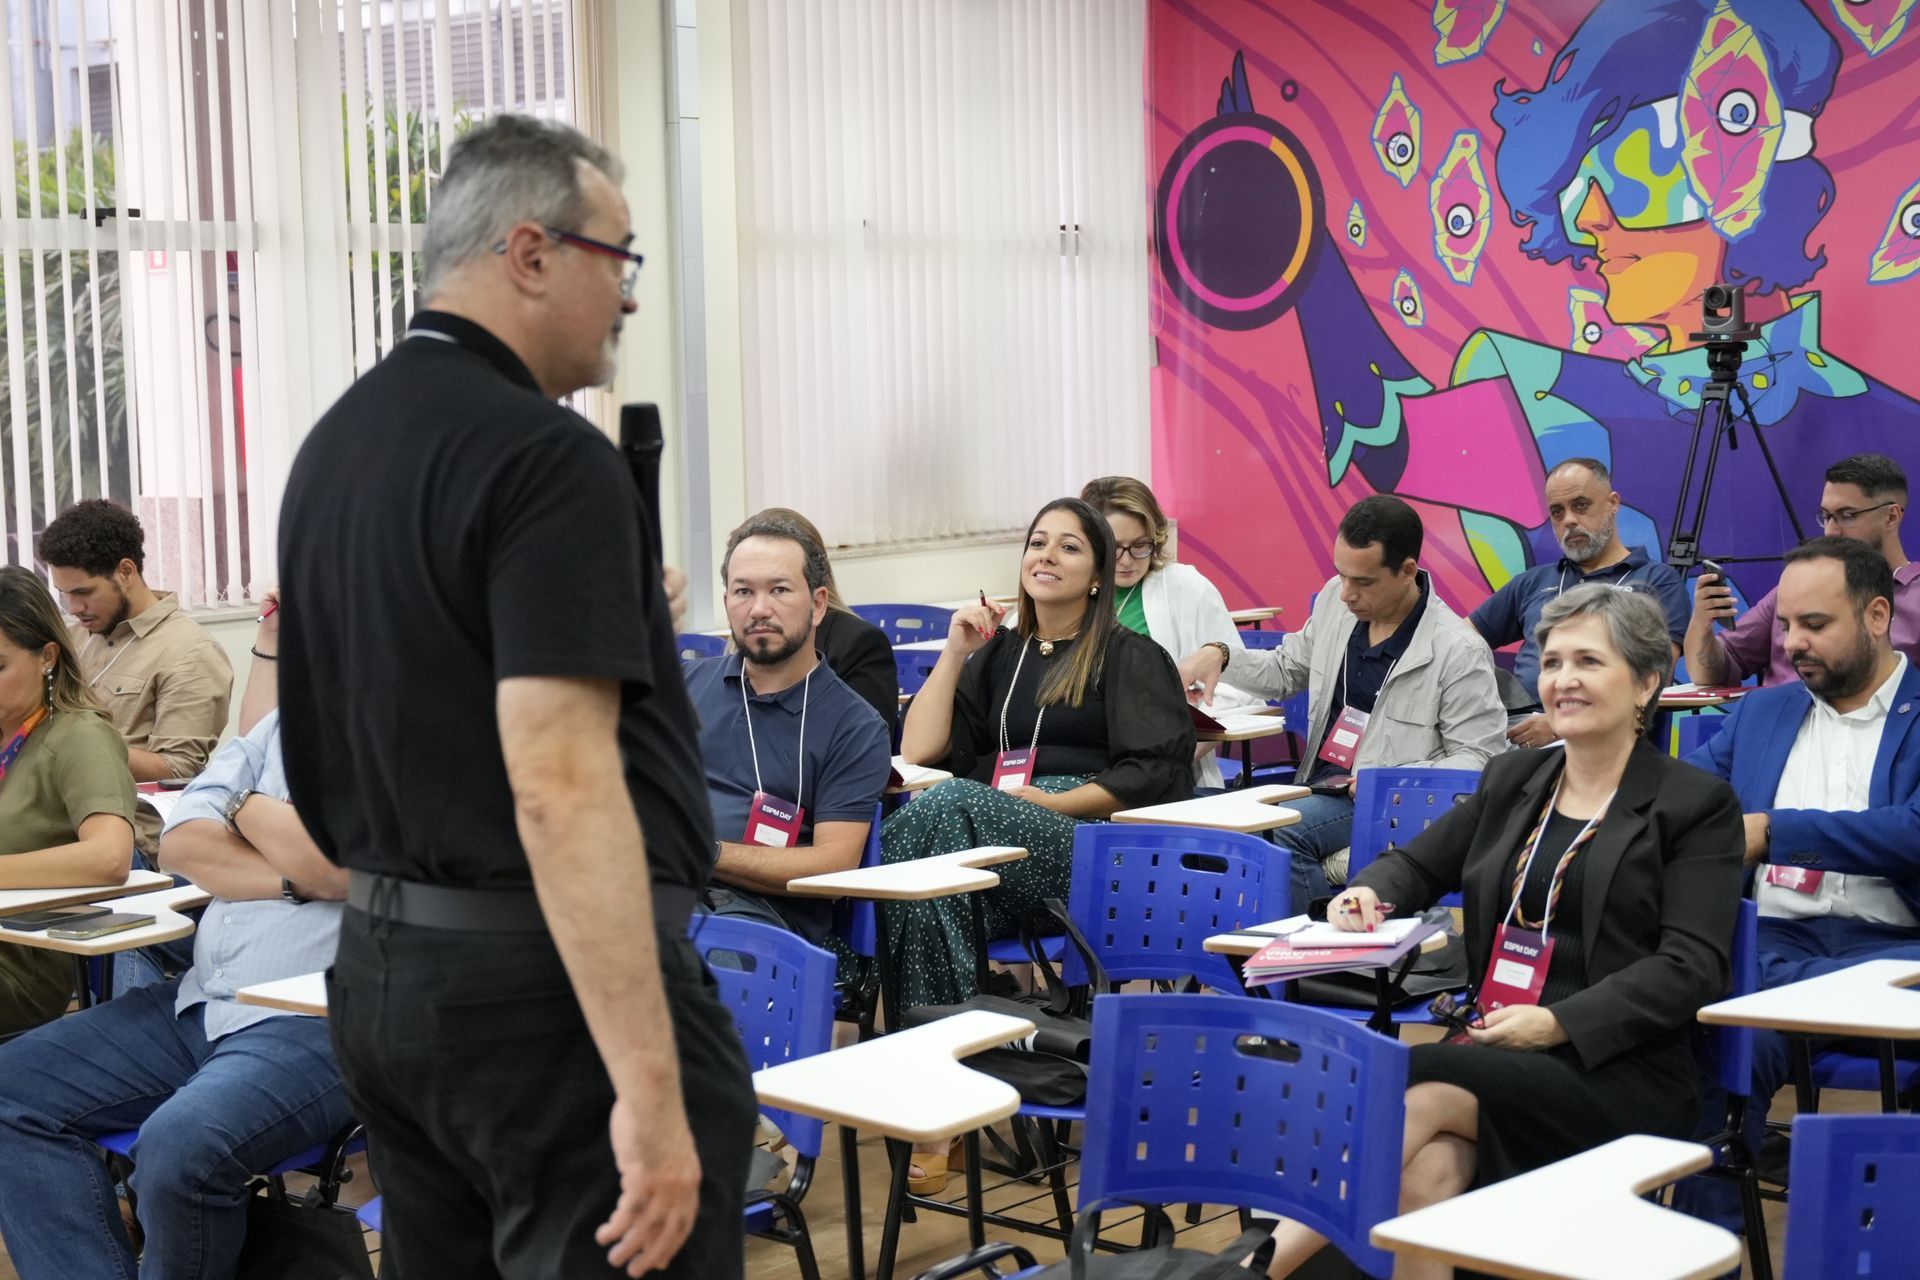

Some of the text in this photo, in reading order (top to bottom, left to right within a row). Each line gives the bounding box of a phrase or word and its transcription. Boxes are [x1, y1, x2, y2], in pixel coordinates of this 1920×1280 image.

[762, 805, 792, 821] ESPM DAY
[1503, 941, 1538, 957] ESPM DAY
